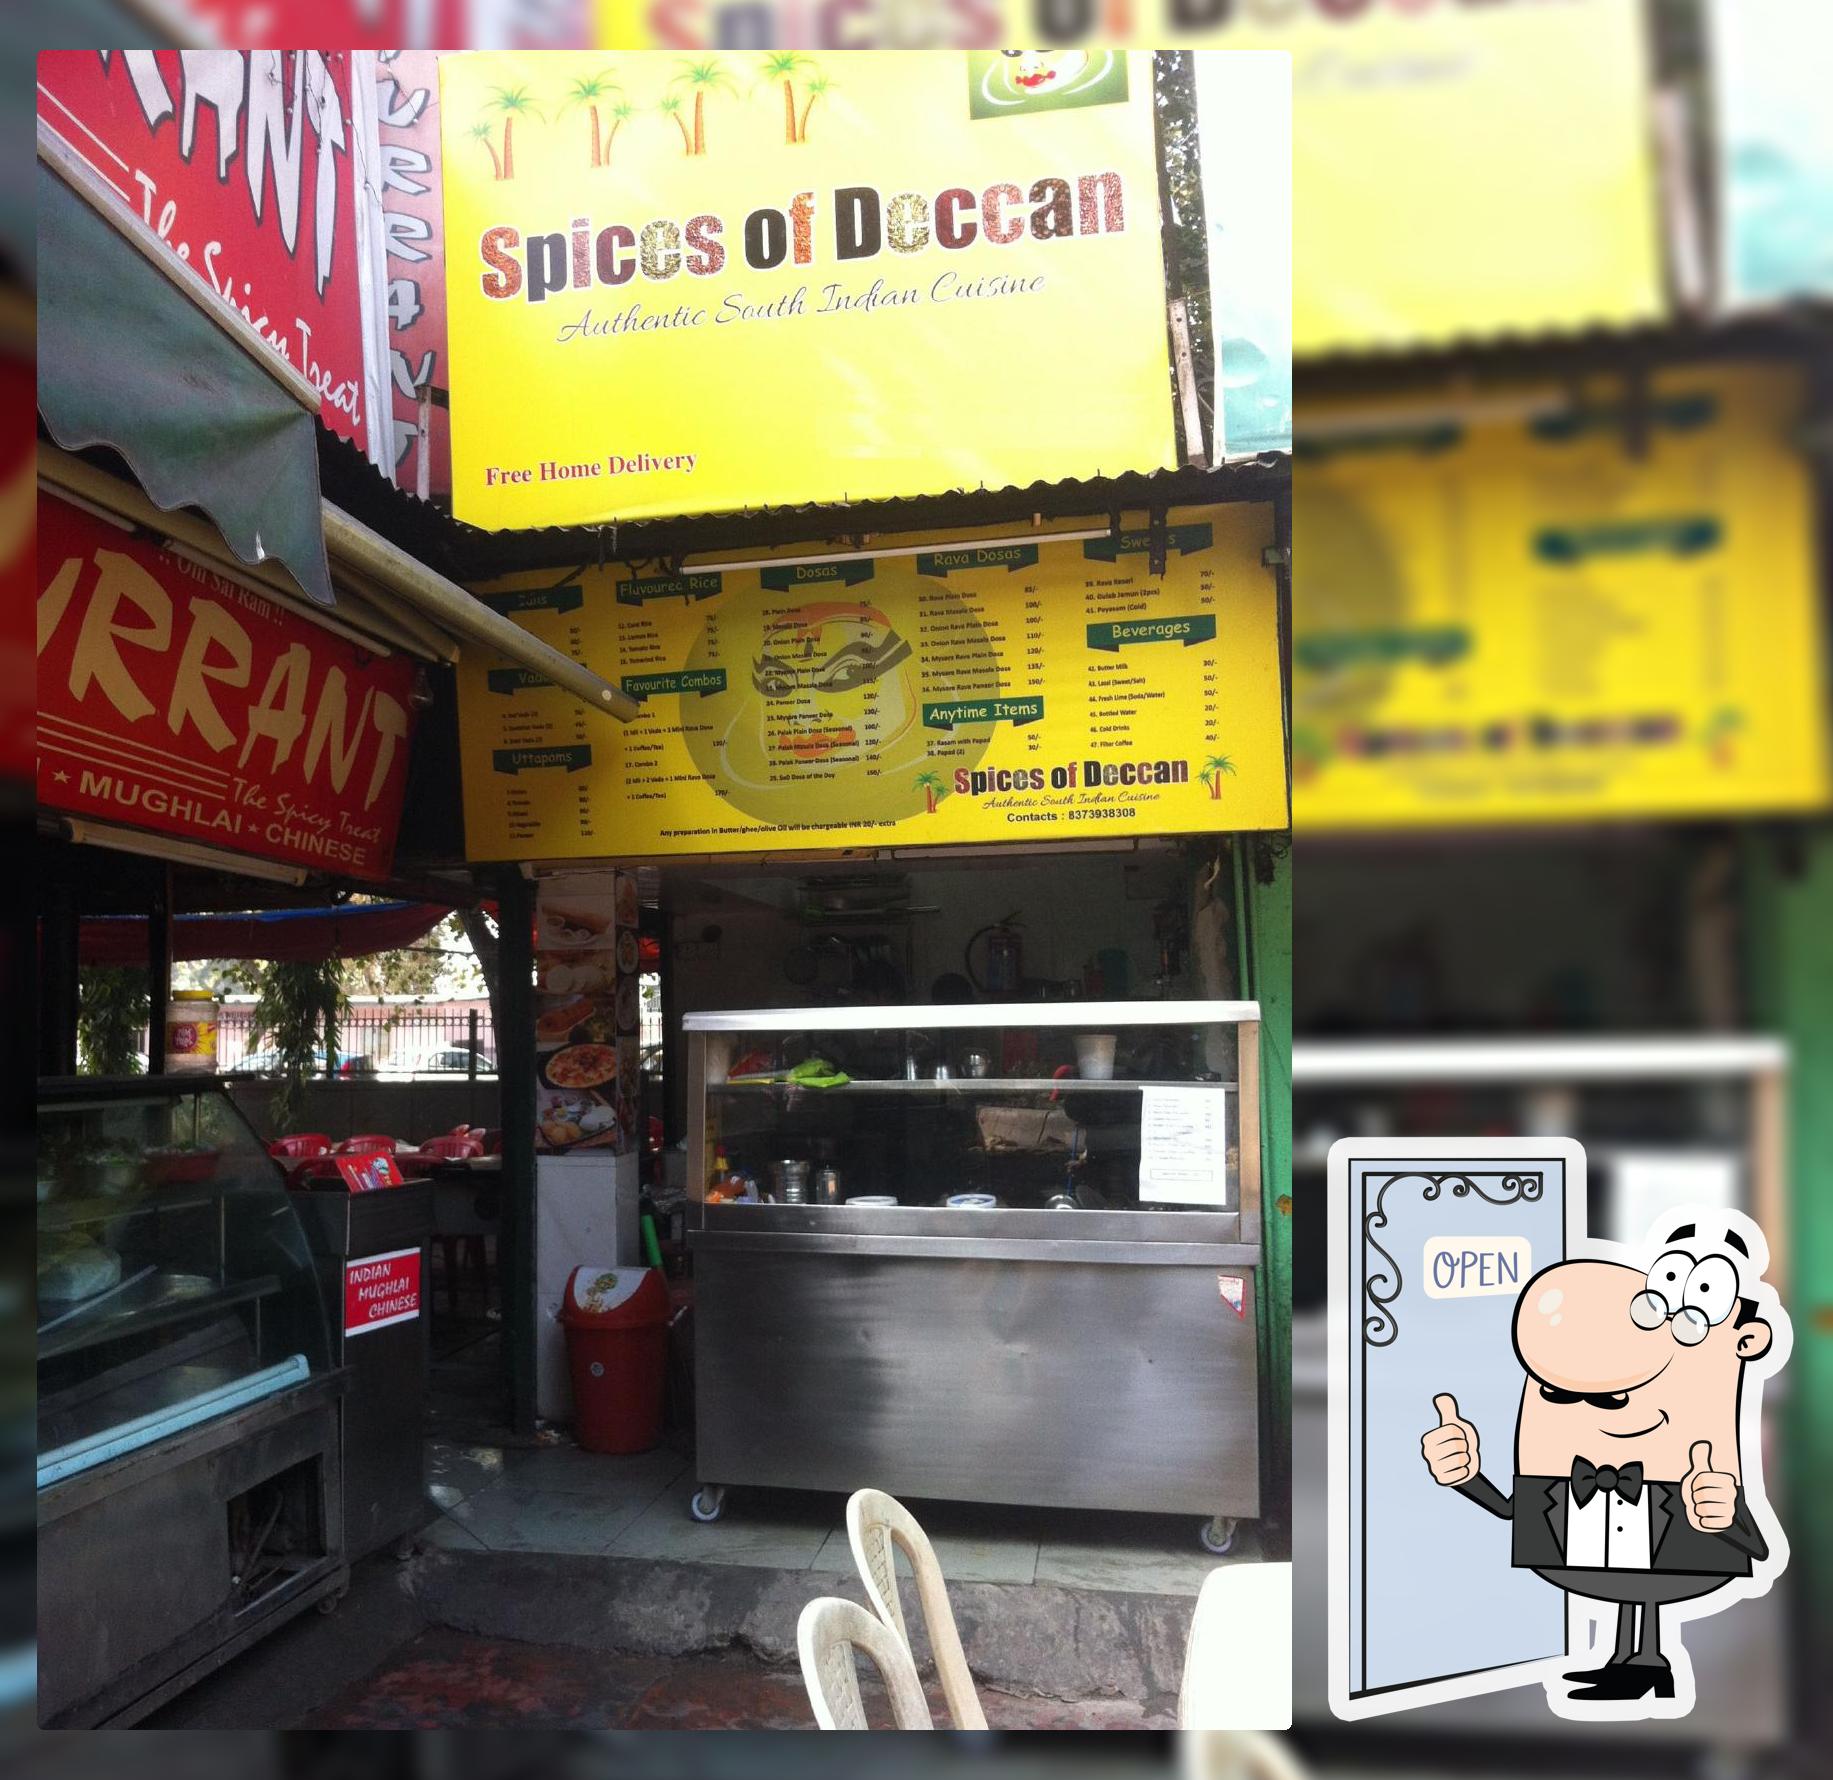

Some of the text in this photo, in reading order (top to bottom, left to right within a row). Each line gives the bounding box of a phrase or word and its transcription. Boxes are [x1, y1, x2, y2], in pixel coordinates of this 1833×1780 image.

[481, 171, 1125, 302] Spices of Deccan
[557, 271, 1046, 341] Authentic South Indian Cuisine
[296, 318, 360, 425] Treat
[486, 452, 697, 486] Free Home Delivery
[1120, 533, 1177, 549] Swes
[934, 546, 1021, 567] Rava Dosas
[689, 576, 719, 591] Rice
[796, 565, 839, 580] Dosas
[1113, 620, 1191, 640] Beverages
[626, 673, 721, 693] Favourite Combos
[930, 703, 1037, 725] Anytime Items
[953, 758, 1188, 797] Spices of Deccan
[234, 777, 382, 844] The Spicy Treat
[981, 787, 1160, 812] Authentic South Indian Cuisine
[80, 769, 366, 866] MUGHLAI CHINESE
[1007, 809, 1136, 822] Contacts 8373938308
[672, 827, 710, 836] preparation
[719, 824, 776, 834] Butter/ghee/olive
[811, 821, 848, 831] chargeable
[350, 1262, 391, 1285] INDIAN
[358, 1276, 410, 1301] MUGHLAI
[368, 1292, 417, 1319] CHINESE
